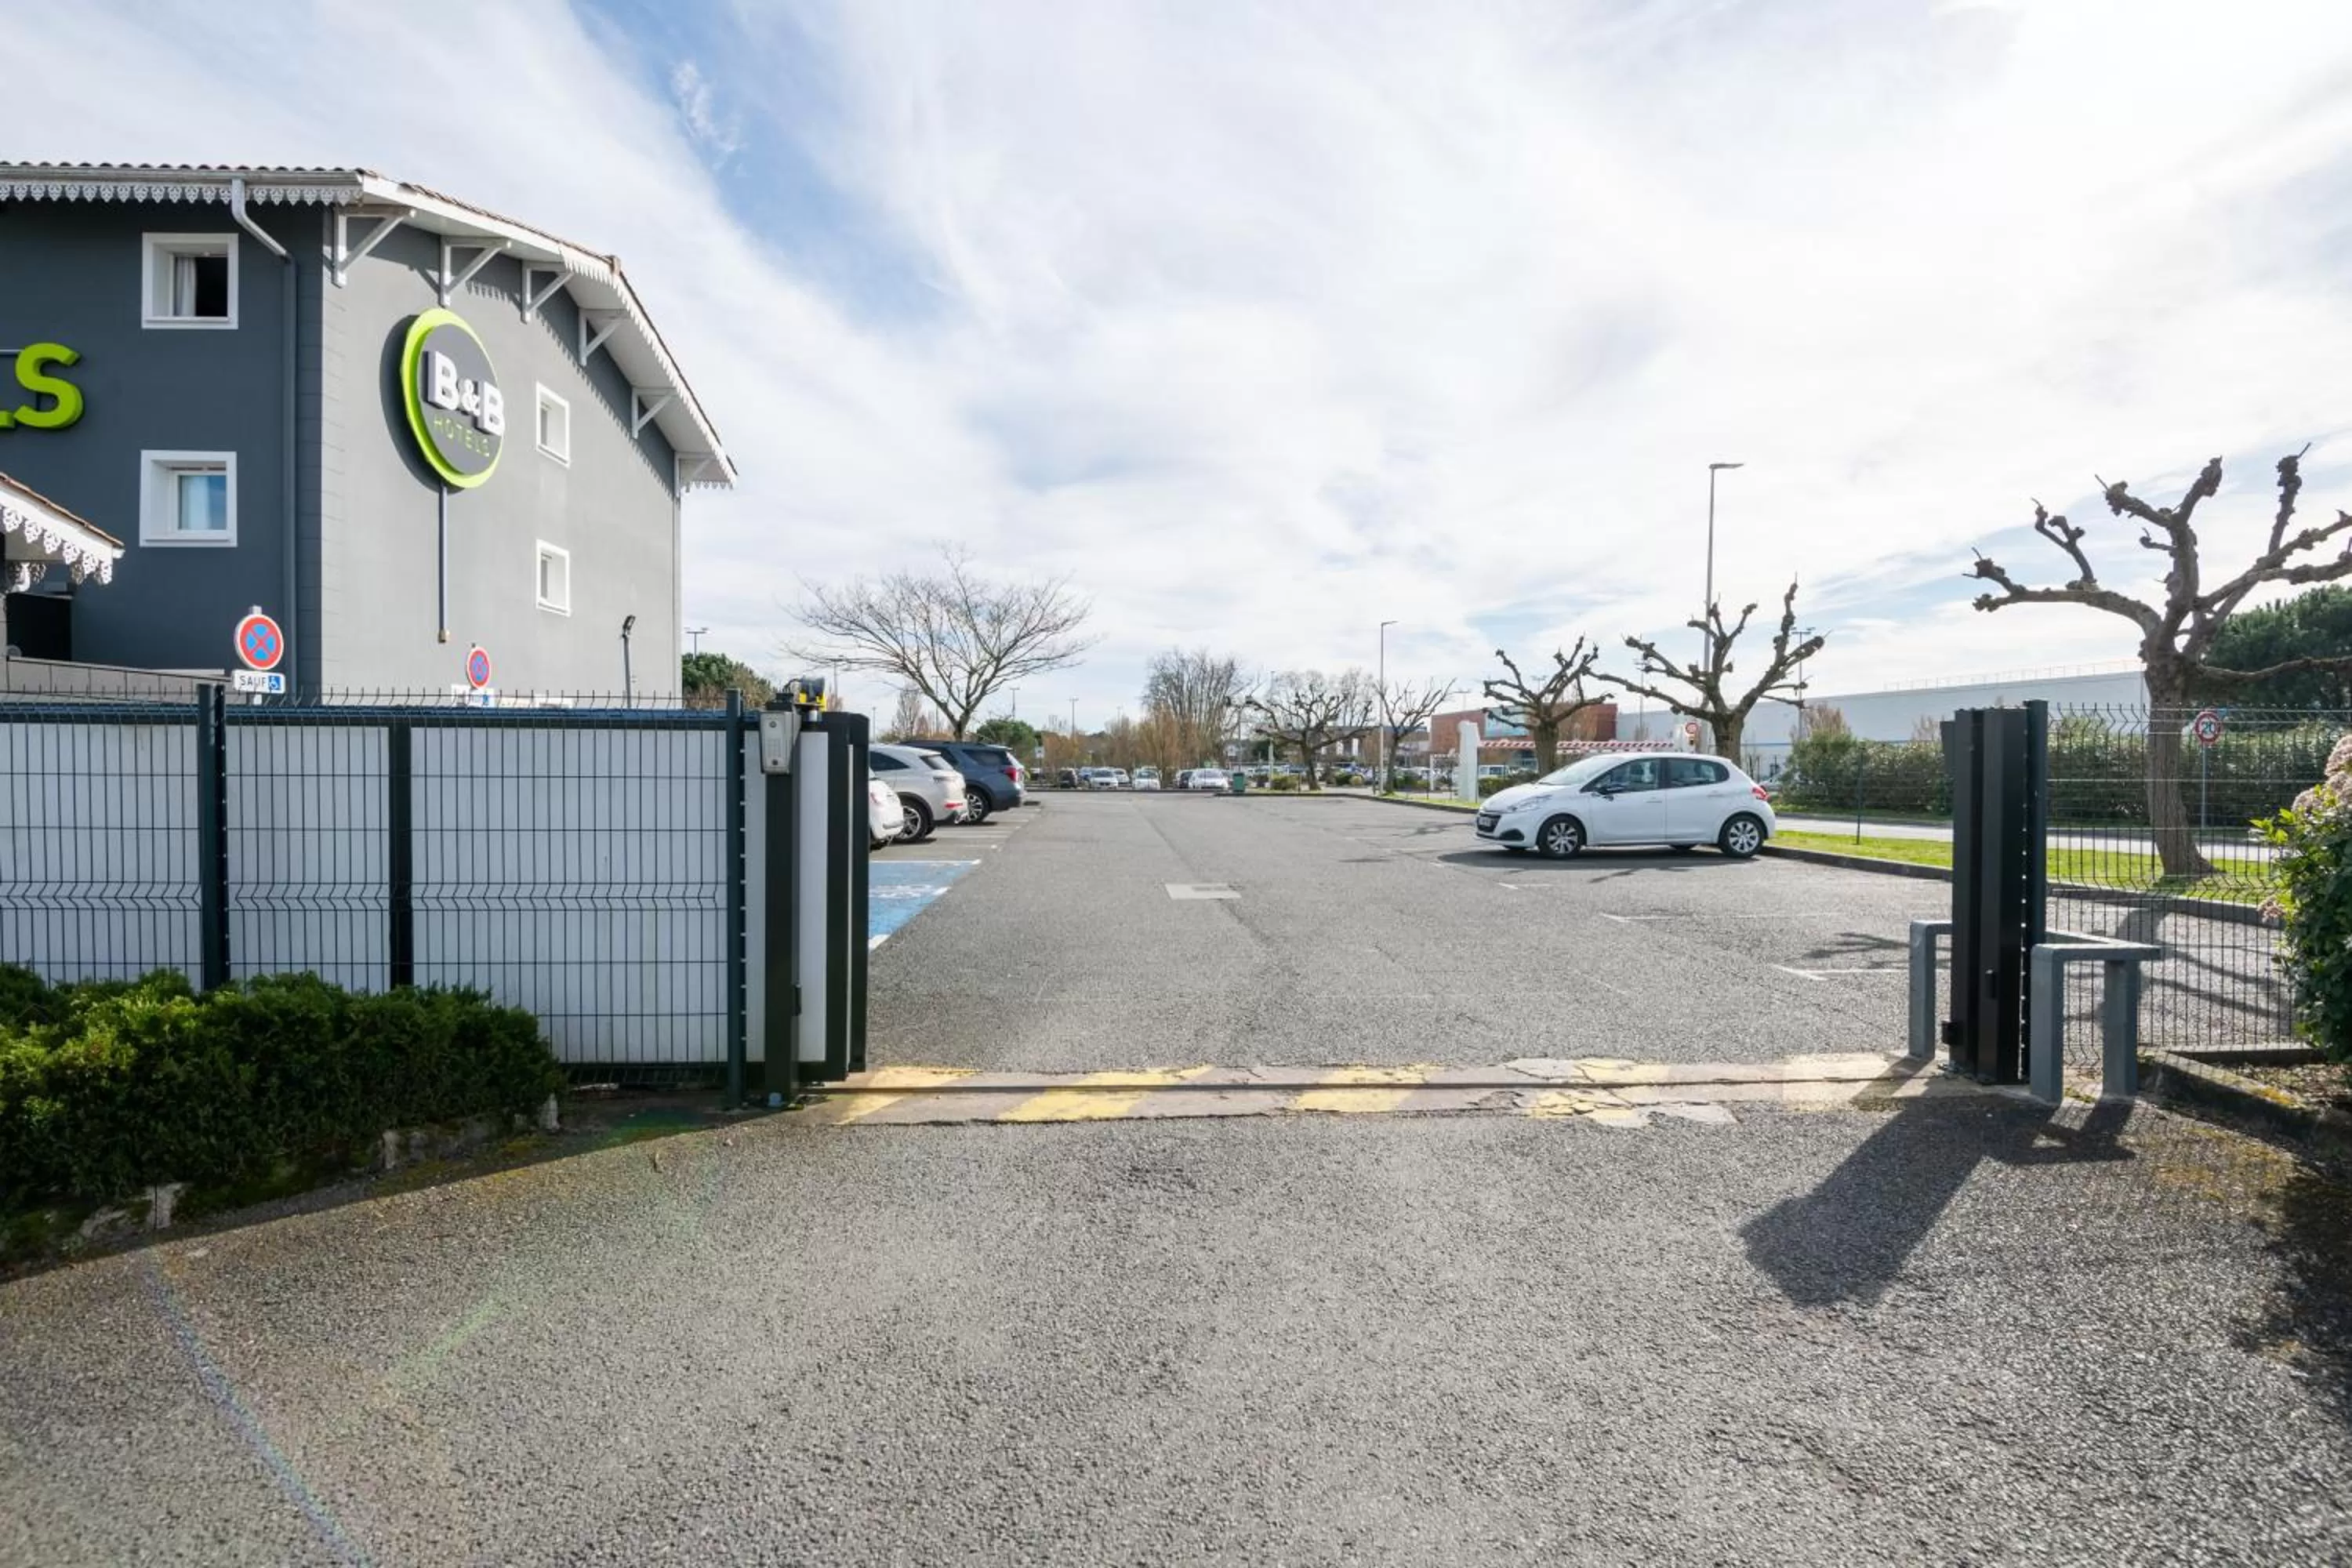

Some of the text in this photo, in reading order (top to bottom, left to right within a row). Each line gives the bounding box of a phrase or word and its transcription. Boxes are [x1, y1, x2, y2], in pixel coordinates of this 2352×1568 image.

[428, 351, 506, 437] B&B
[434, 414, 490, 458] HOTELS
[239, 675, 267, 688] SAUF
